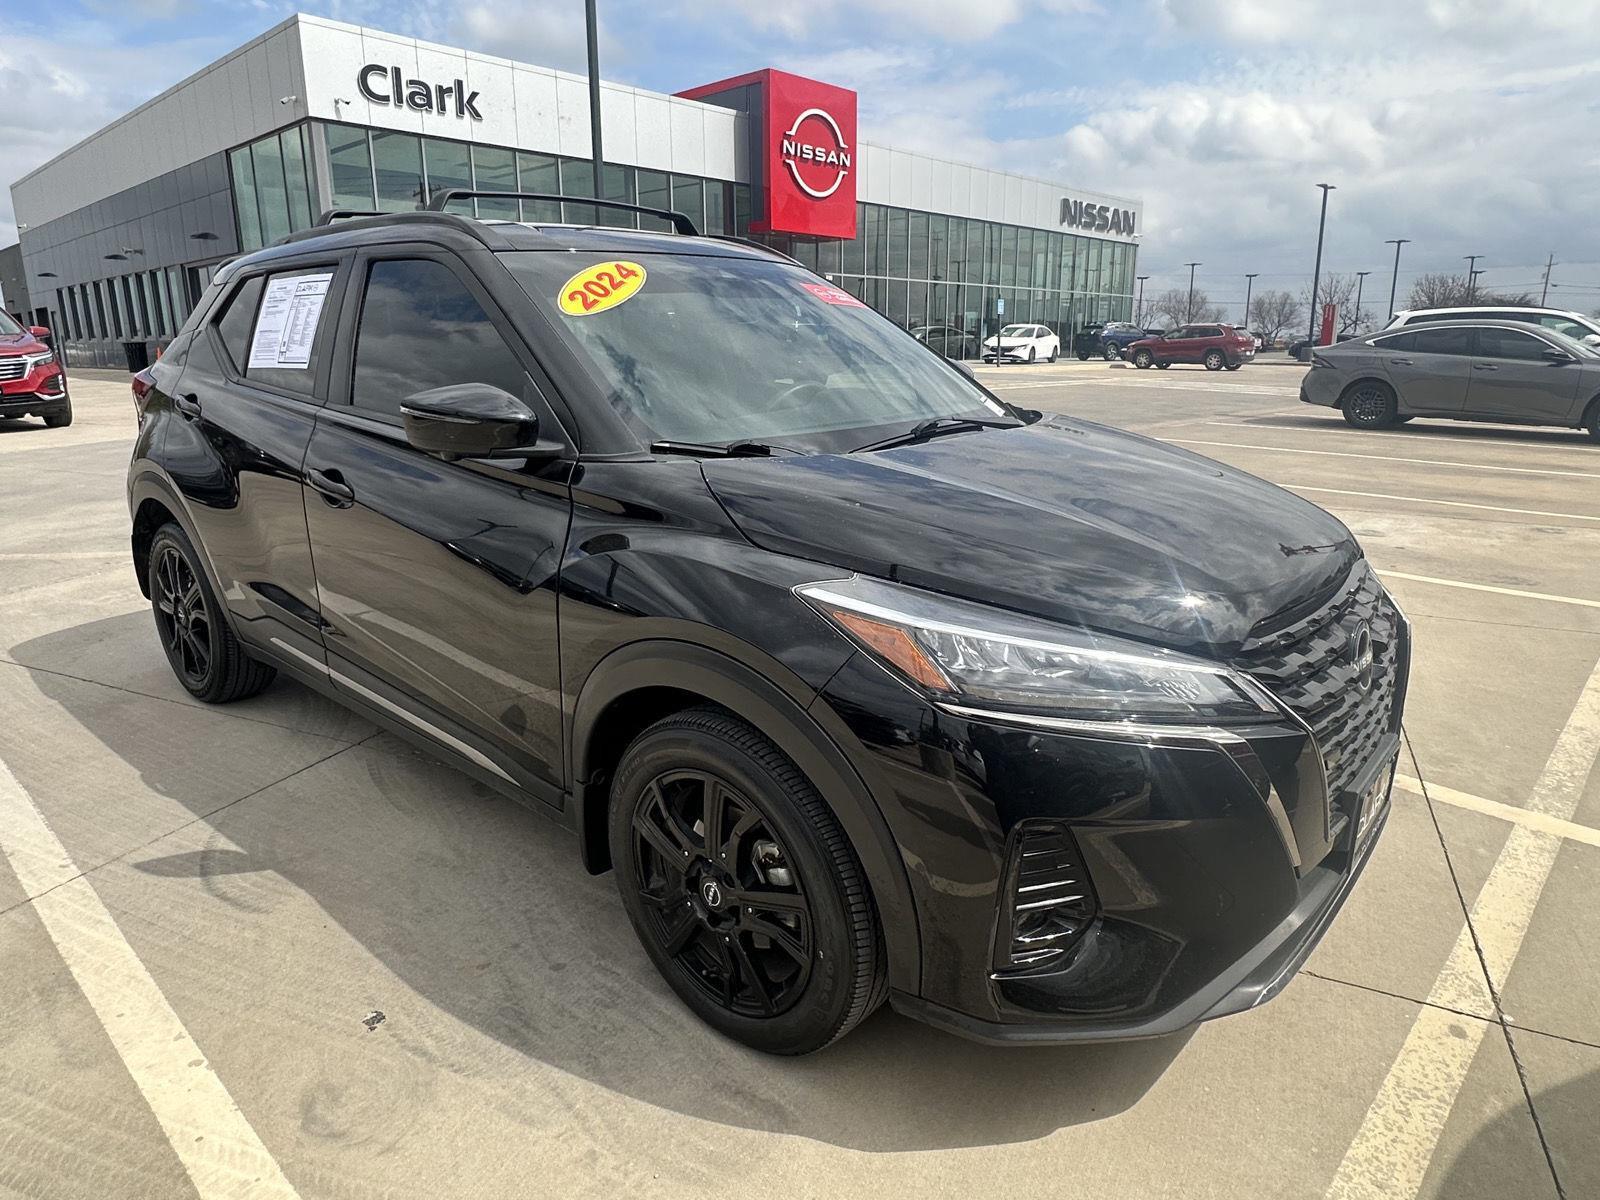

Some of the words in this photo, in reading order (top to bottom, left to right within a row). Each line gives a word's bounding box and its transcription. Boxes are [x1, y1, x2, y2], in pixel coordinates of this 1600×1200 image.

[358, 64, 483, 120] Clark
[782, 139, 850, 167] NISSAN
[1060, 197, 1135, 237] NISSAN
[568, 263, 640, 312] 2024
